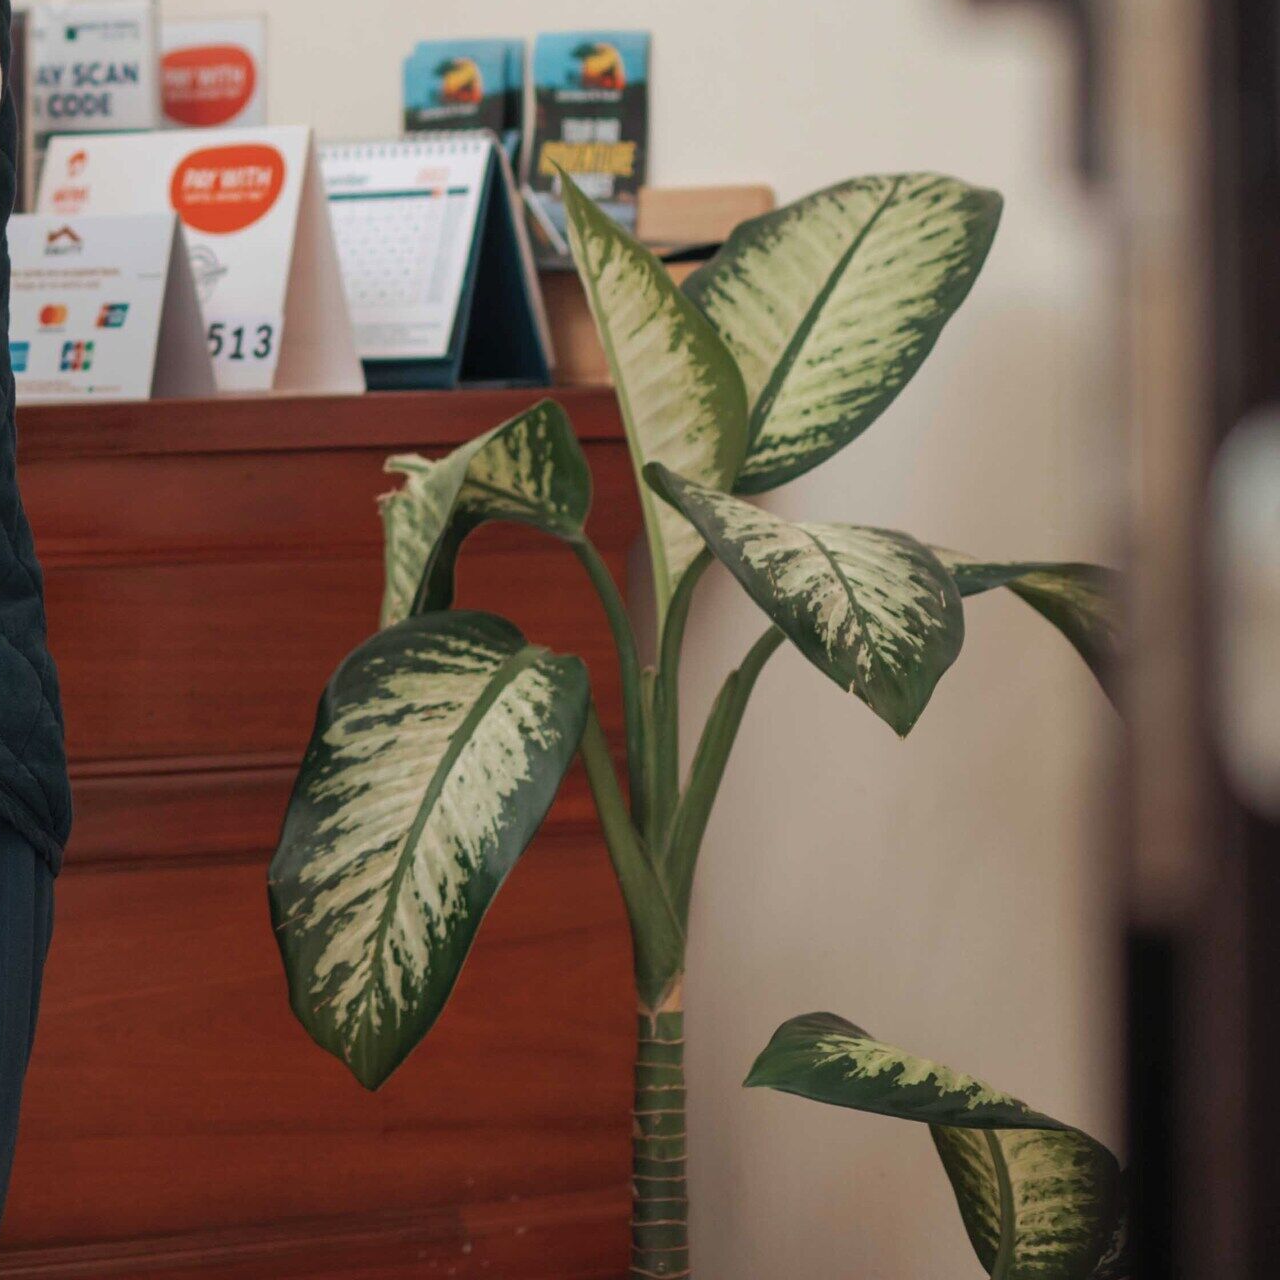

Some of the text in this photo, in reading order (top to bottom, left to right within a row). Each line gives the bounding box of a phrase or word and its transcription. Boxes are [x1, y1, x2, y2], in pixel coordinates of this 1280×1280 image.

[73, 61, 139, 86] SCAN
[47, 92, 111, 118] CODE
[183, 165, 273, 189] PAY WITH
[207, 322, 273, 360] 513
